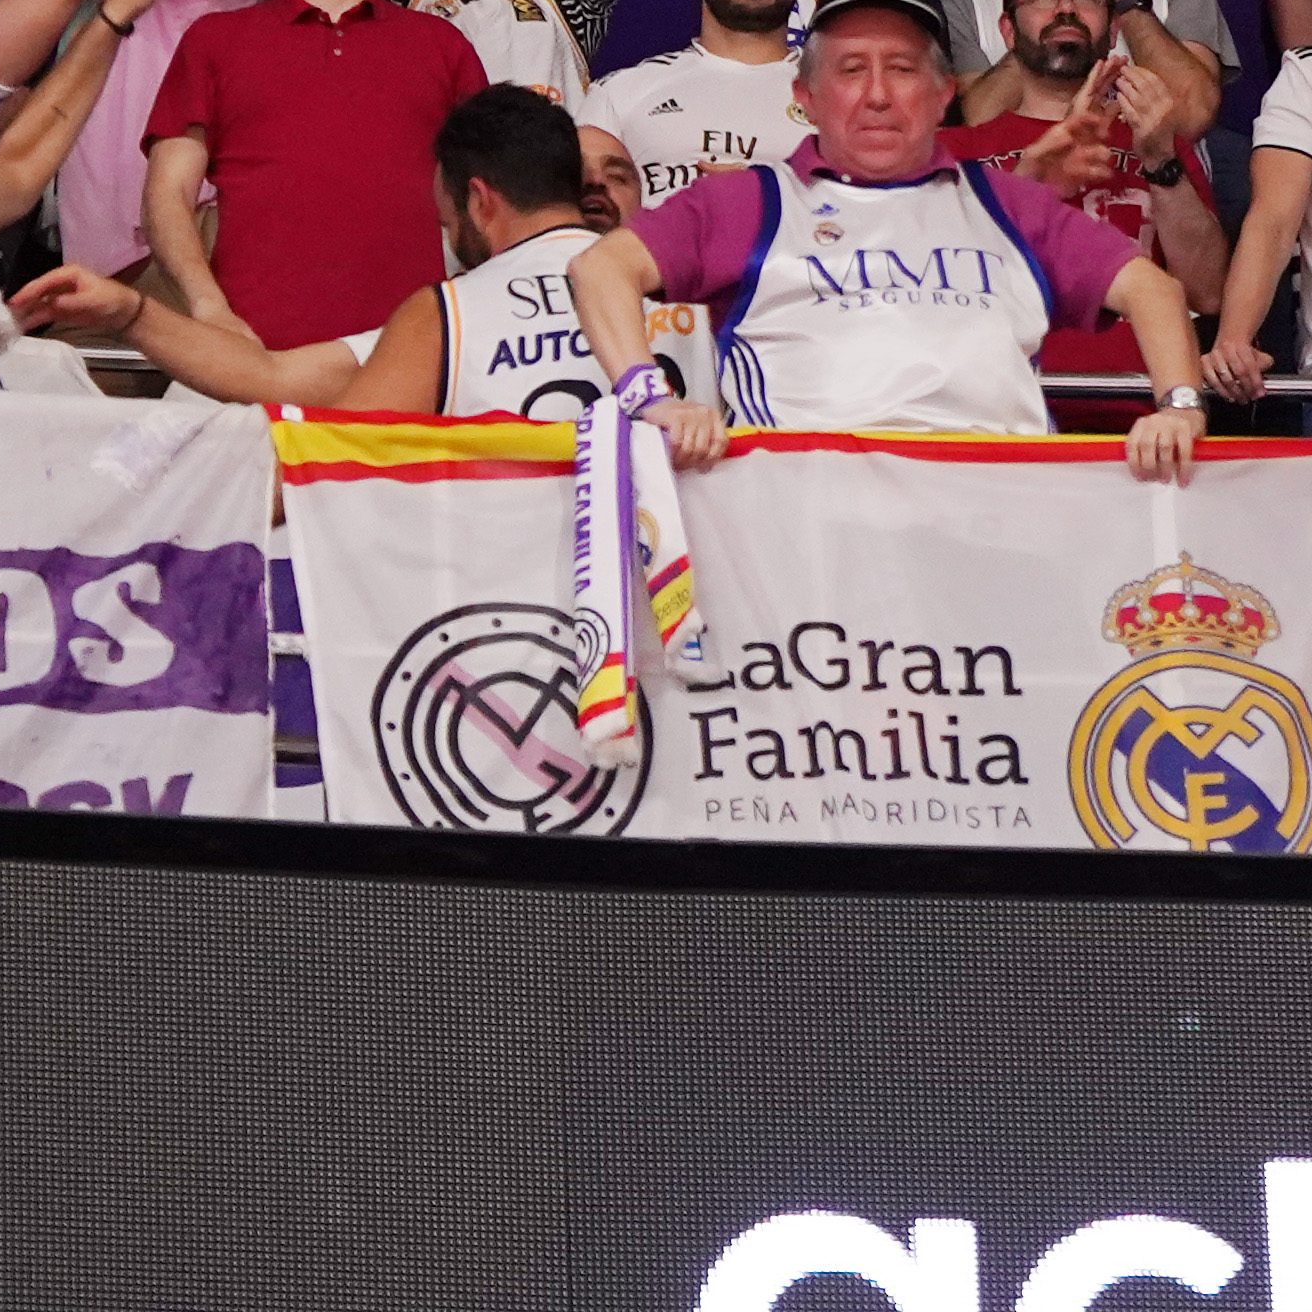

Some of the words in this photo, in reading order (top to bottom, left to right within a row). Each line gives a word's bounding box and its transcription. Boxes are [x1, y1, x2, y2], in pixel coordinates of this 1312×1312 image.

[797, 247, 1004, 306] MMT
[838, 291, 992, 312] SEGUROS
[688, 707, 1030, 786] Familia
[704, 796, 798, 824] PEÑA
[819, 792, 1033, 830] MADRIDISTA
